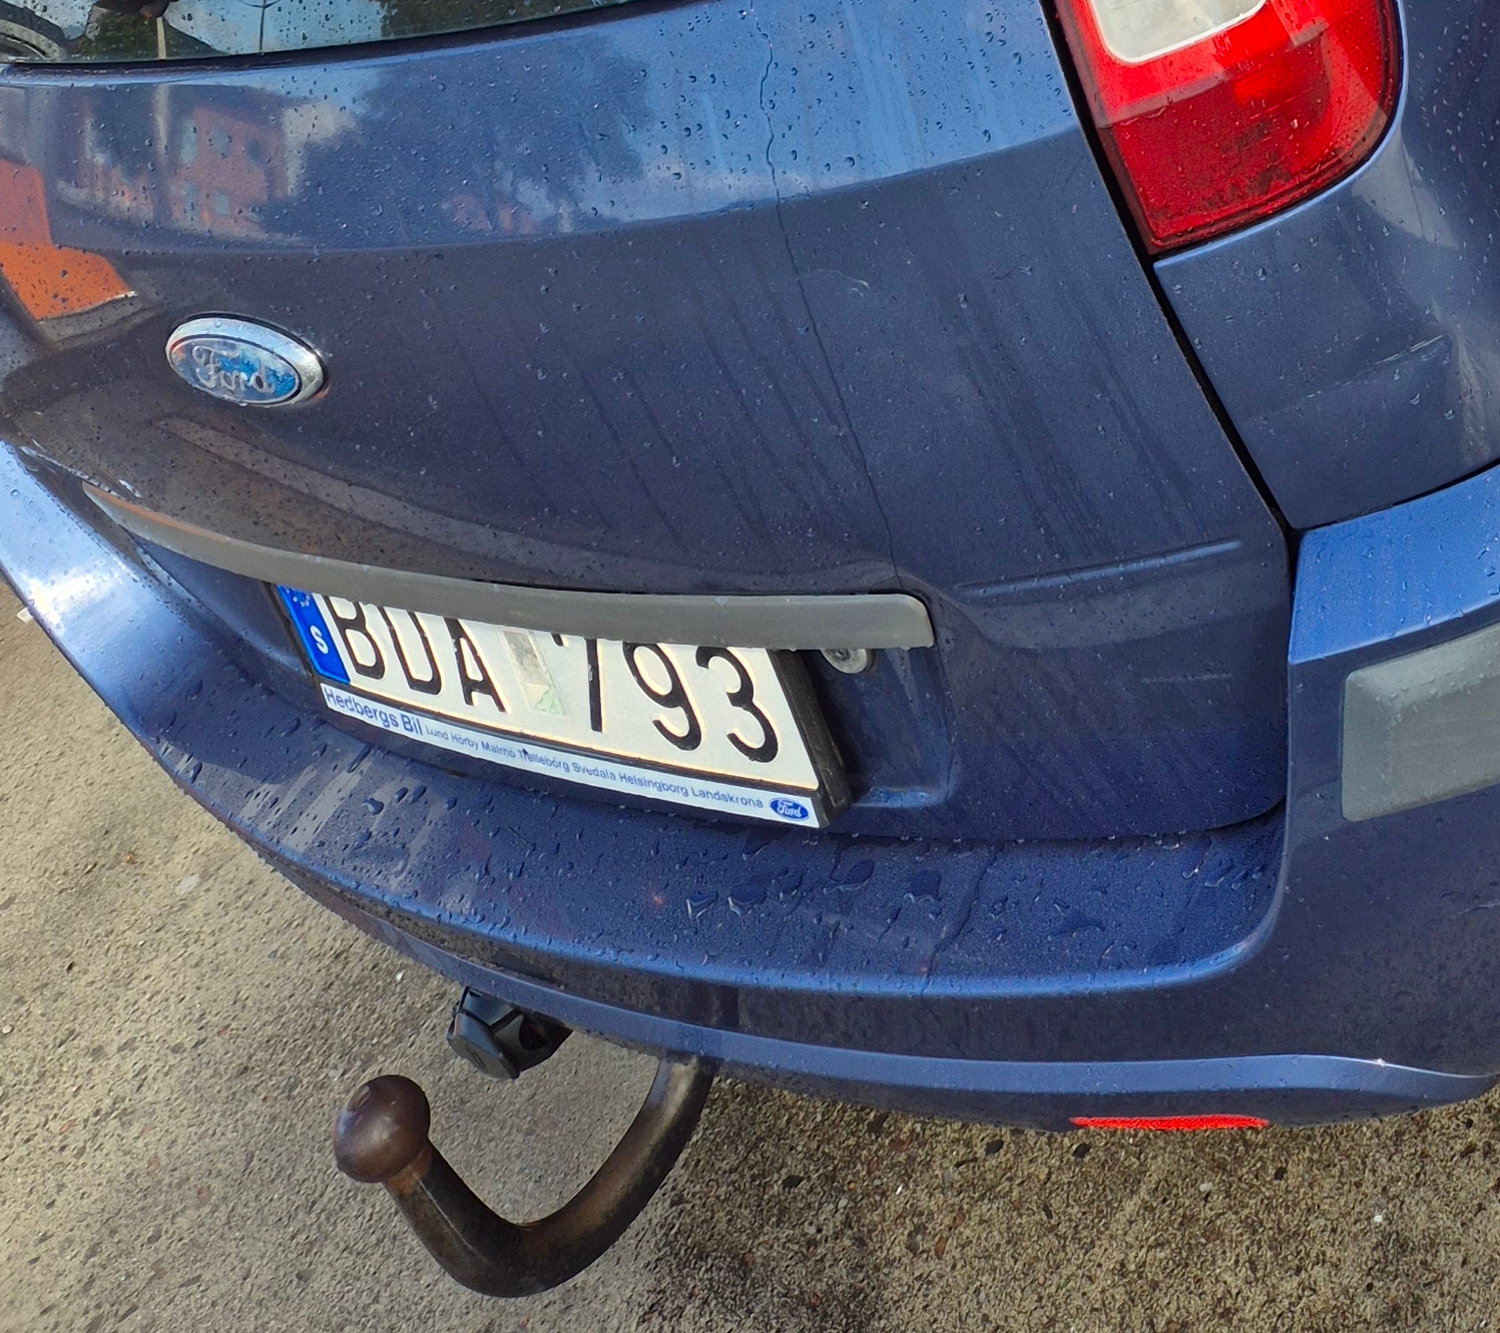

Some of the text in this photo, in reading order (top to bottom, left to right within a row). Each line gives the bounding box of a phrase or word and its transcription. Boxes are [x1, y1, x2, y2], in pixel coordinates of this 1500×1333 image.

[192, 345, 275, 393] Ford
[309, 623, 329, 655] S
[330, 599, 509, 714] BDA
[323, 687, 423, 736] Hedbergs Bil
[425, 725, 449, 741] Lund
[480, 740, 516, 758] Malmö
[517, 749, 570, 774] Trelleborg
[571, 762, 616, 781] Svedala
[618, 771, 690, 797] Helsingborg
[690, 787, 764, 809] Landskrona
[778, 799, 803, 818] Ford
